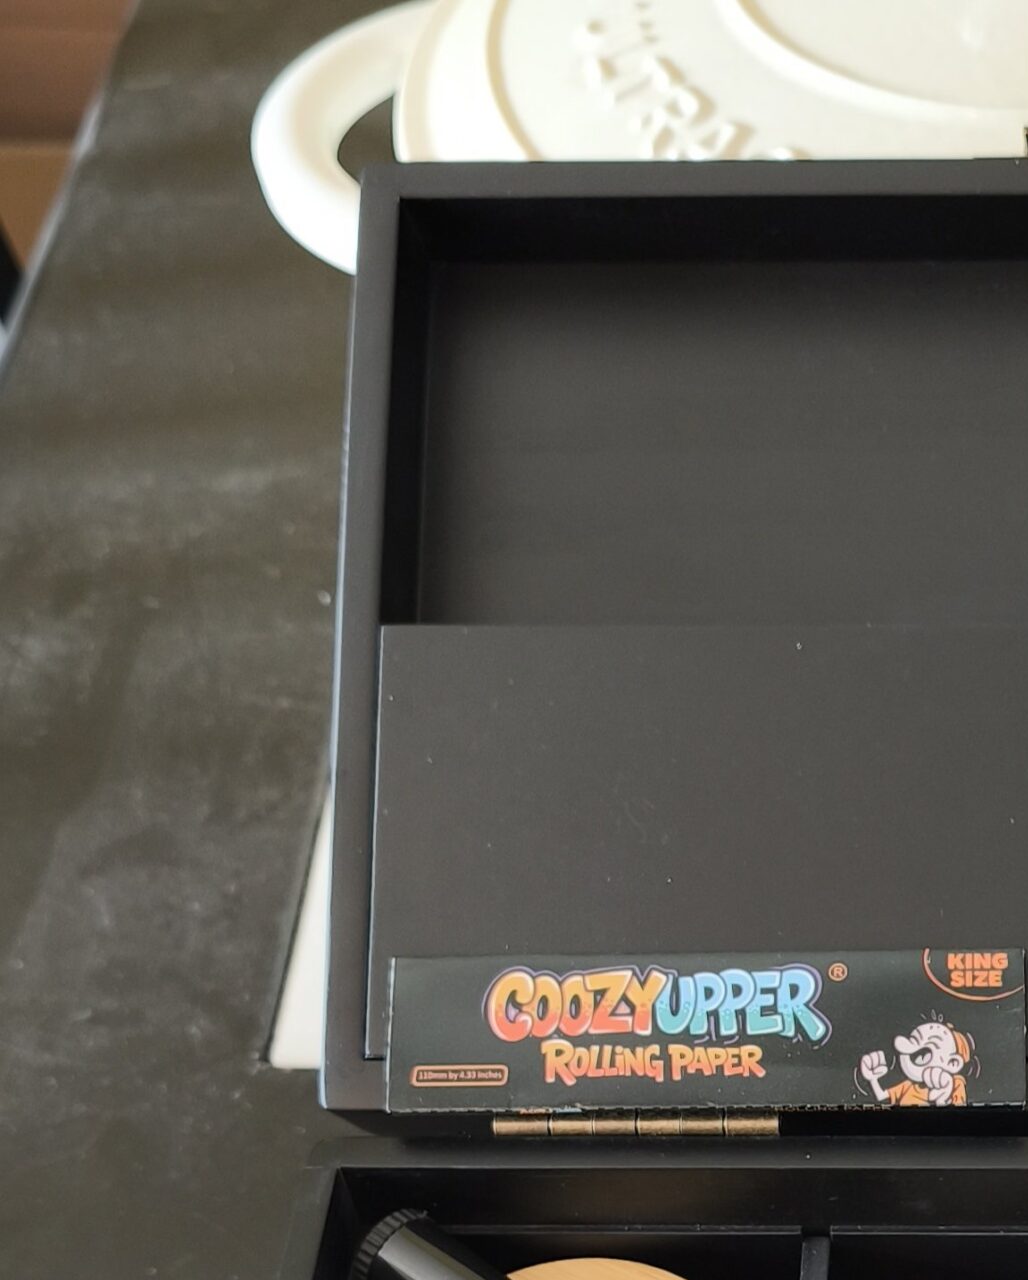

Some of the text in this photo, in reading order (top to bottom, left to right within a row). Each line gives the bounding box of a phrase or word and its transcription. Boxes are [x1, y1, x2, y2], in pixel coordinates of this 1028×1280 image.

[947, 952, 1008, 970] KING
[950, 970, 1003, 988] SIZE
[667, 1043, 767, 1080] PAPER
[448, 1071, 459, 1081] by
